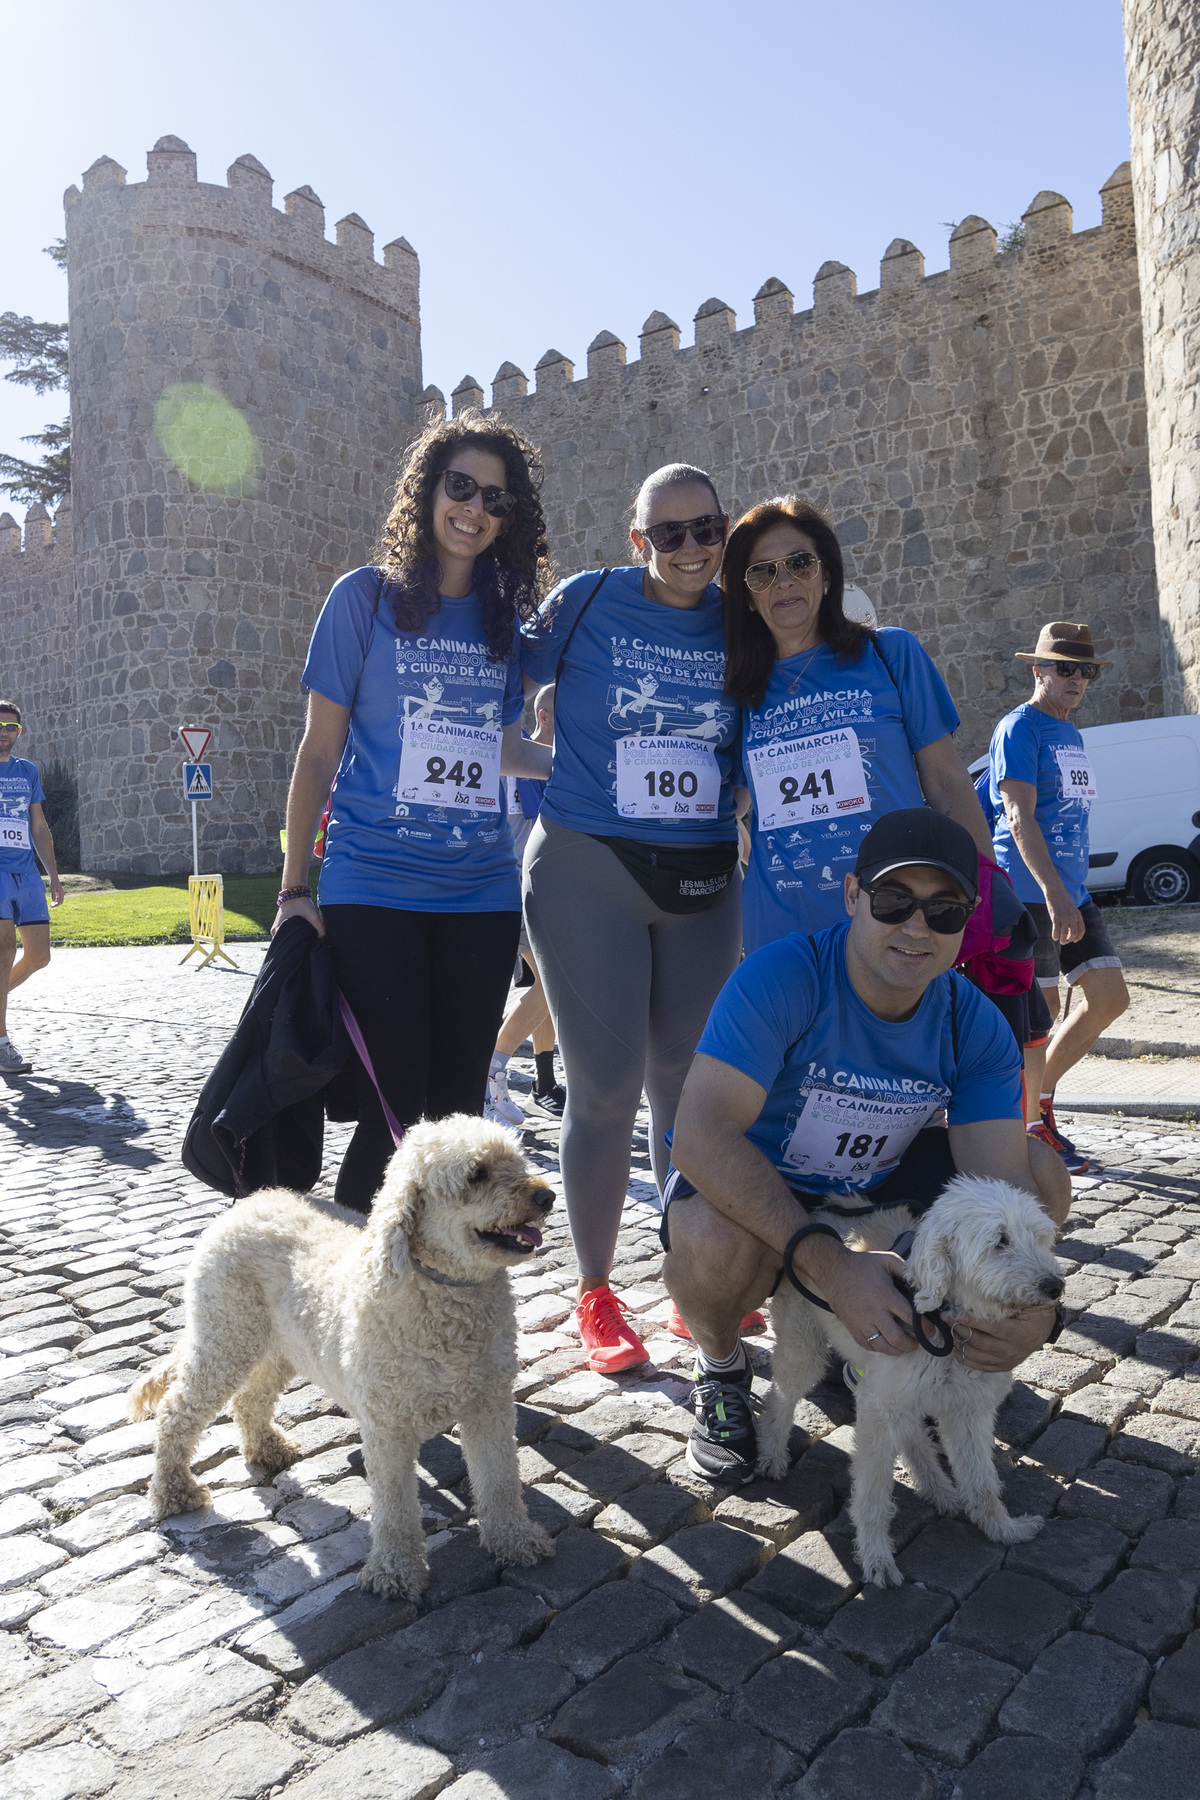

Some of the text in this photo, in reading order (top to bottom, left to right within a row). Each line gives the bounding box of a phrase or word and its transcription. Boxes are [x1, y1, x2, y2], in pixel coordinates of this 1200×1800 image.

[416, 637, 492, 656] CANIMAR
[632, 638, 727, 662] CANIMARCH
[395, 650, 427, 663] POR
[429, 650, 448, 664] LA
[611, 645, 727, 673] POR LA ADOPCIÓ
[410, 662, 456, 675] CIUDAD
[460, 666, 475, 676] DE
[625, 659, 672, 674] CIUDAD
[675, 668, 691, 678] DE
[444, 675, 480, 687] MARCHA
[660, 673, 697, 687] MARCHA
[764, 689, 873, 720] CANIMARCHA
[751, 697, 873, 732] OR LA ADOPCIÓN
[754, 708, 859, 739] CIUDAD DE ÁVILA
[785, 715, 875, 738] MARCHA SOLIDARIA
[410, 731, 433, 743] POR
[435, 734, 449, 744] LA
[427, 723, 498, 743] CANIMARCHA
[420, 741, 455, 753] CIUDAD
[457, 747, 468, 755] DE
[639, 739, 709, 753] CANIMARCHA
[767, 732, 849, 758] CANIMARCHA
[623, 750, 647, 758] POR
[648, 750, 662, 758] LA
[634, 758, 669, 766] CIUDAD
[671, 758, 682, 766] DE
[755, 759, 776, 771] POR
[777, 755, 792, 767] LA
[765, 764, 799, 776] CIUDAD
[801, 759, 813, 768] DE
[423, 756, 483, 790] 242
[1070, 769, 1089, 786] 229
[643, 770, 698, 798] 180
[779, 768, 835, 806] 241
[811, 803, 830, 816] isa
[836, 797, 865, 809] KIWOKO
[2, 830, 23, 841] 105
[820, 829, 851, 838] VELASCO
[680, 873, 728, 888] LES MILLS LIVE
[832, 1071, 953, 1098] CANIMARCHA
[813, 1102, 842, 1117] POR
[843, 1109, 860, 1121] LA
[836, 1098, 928, 1116] CANIMARCHA
[822, 1114, 865, 1128] CIUDAD
[867, 1122, 881, 1130] DE
[834, 1132, 889, 1159] 181
